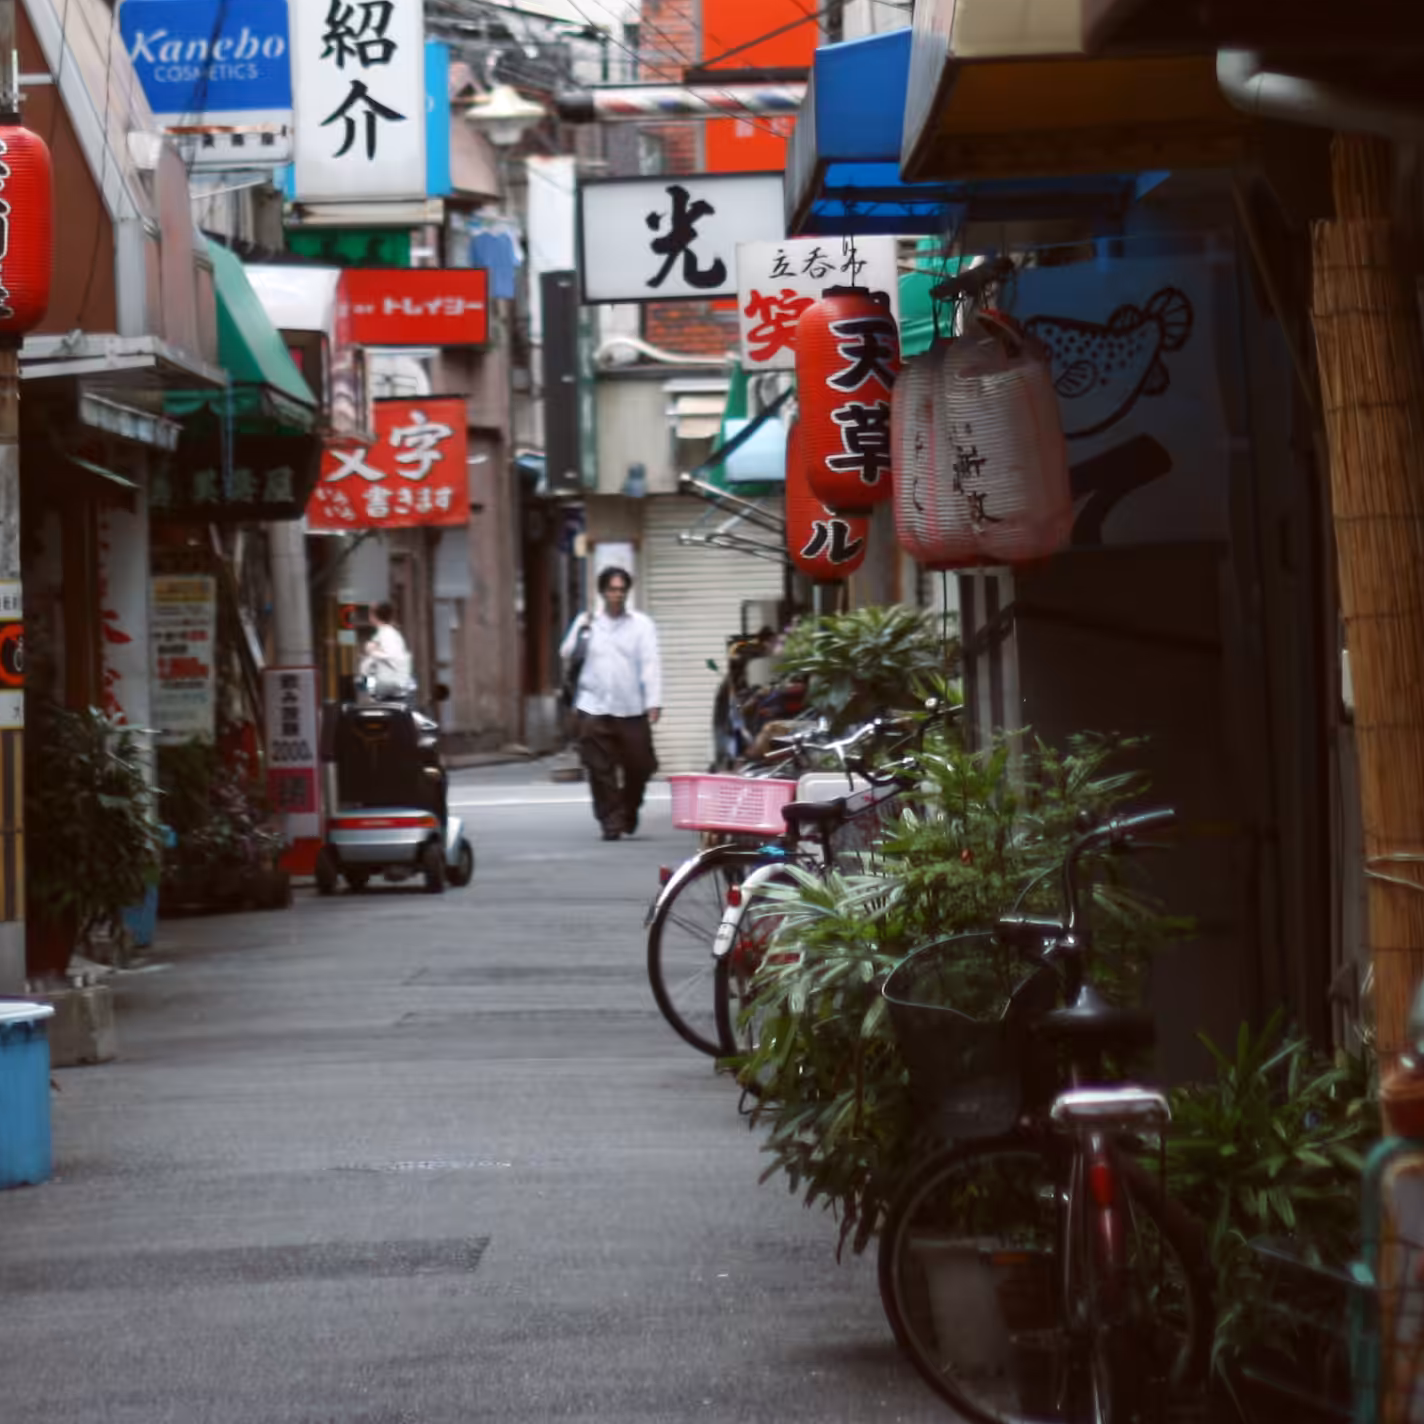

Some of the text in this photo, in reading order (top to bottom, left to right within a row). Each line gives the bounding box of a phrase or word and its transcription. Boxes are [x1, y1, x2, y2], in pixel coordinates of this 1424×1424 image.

[130, 26, 286, 64] Kanebo
[645, 185, 728, 290] 光
[826, 315, 897, 487] 天草
